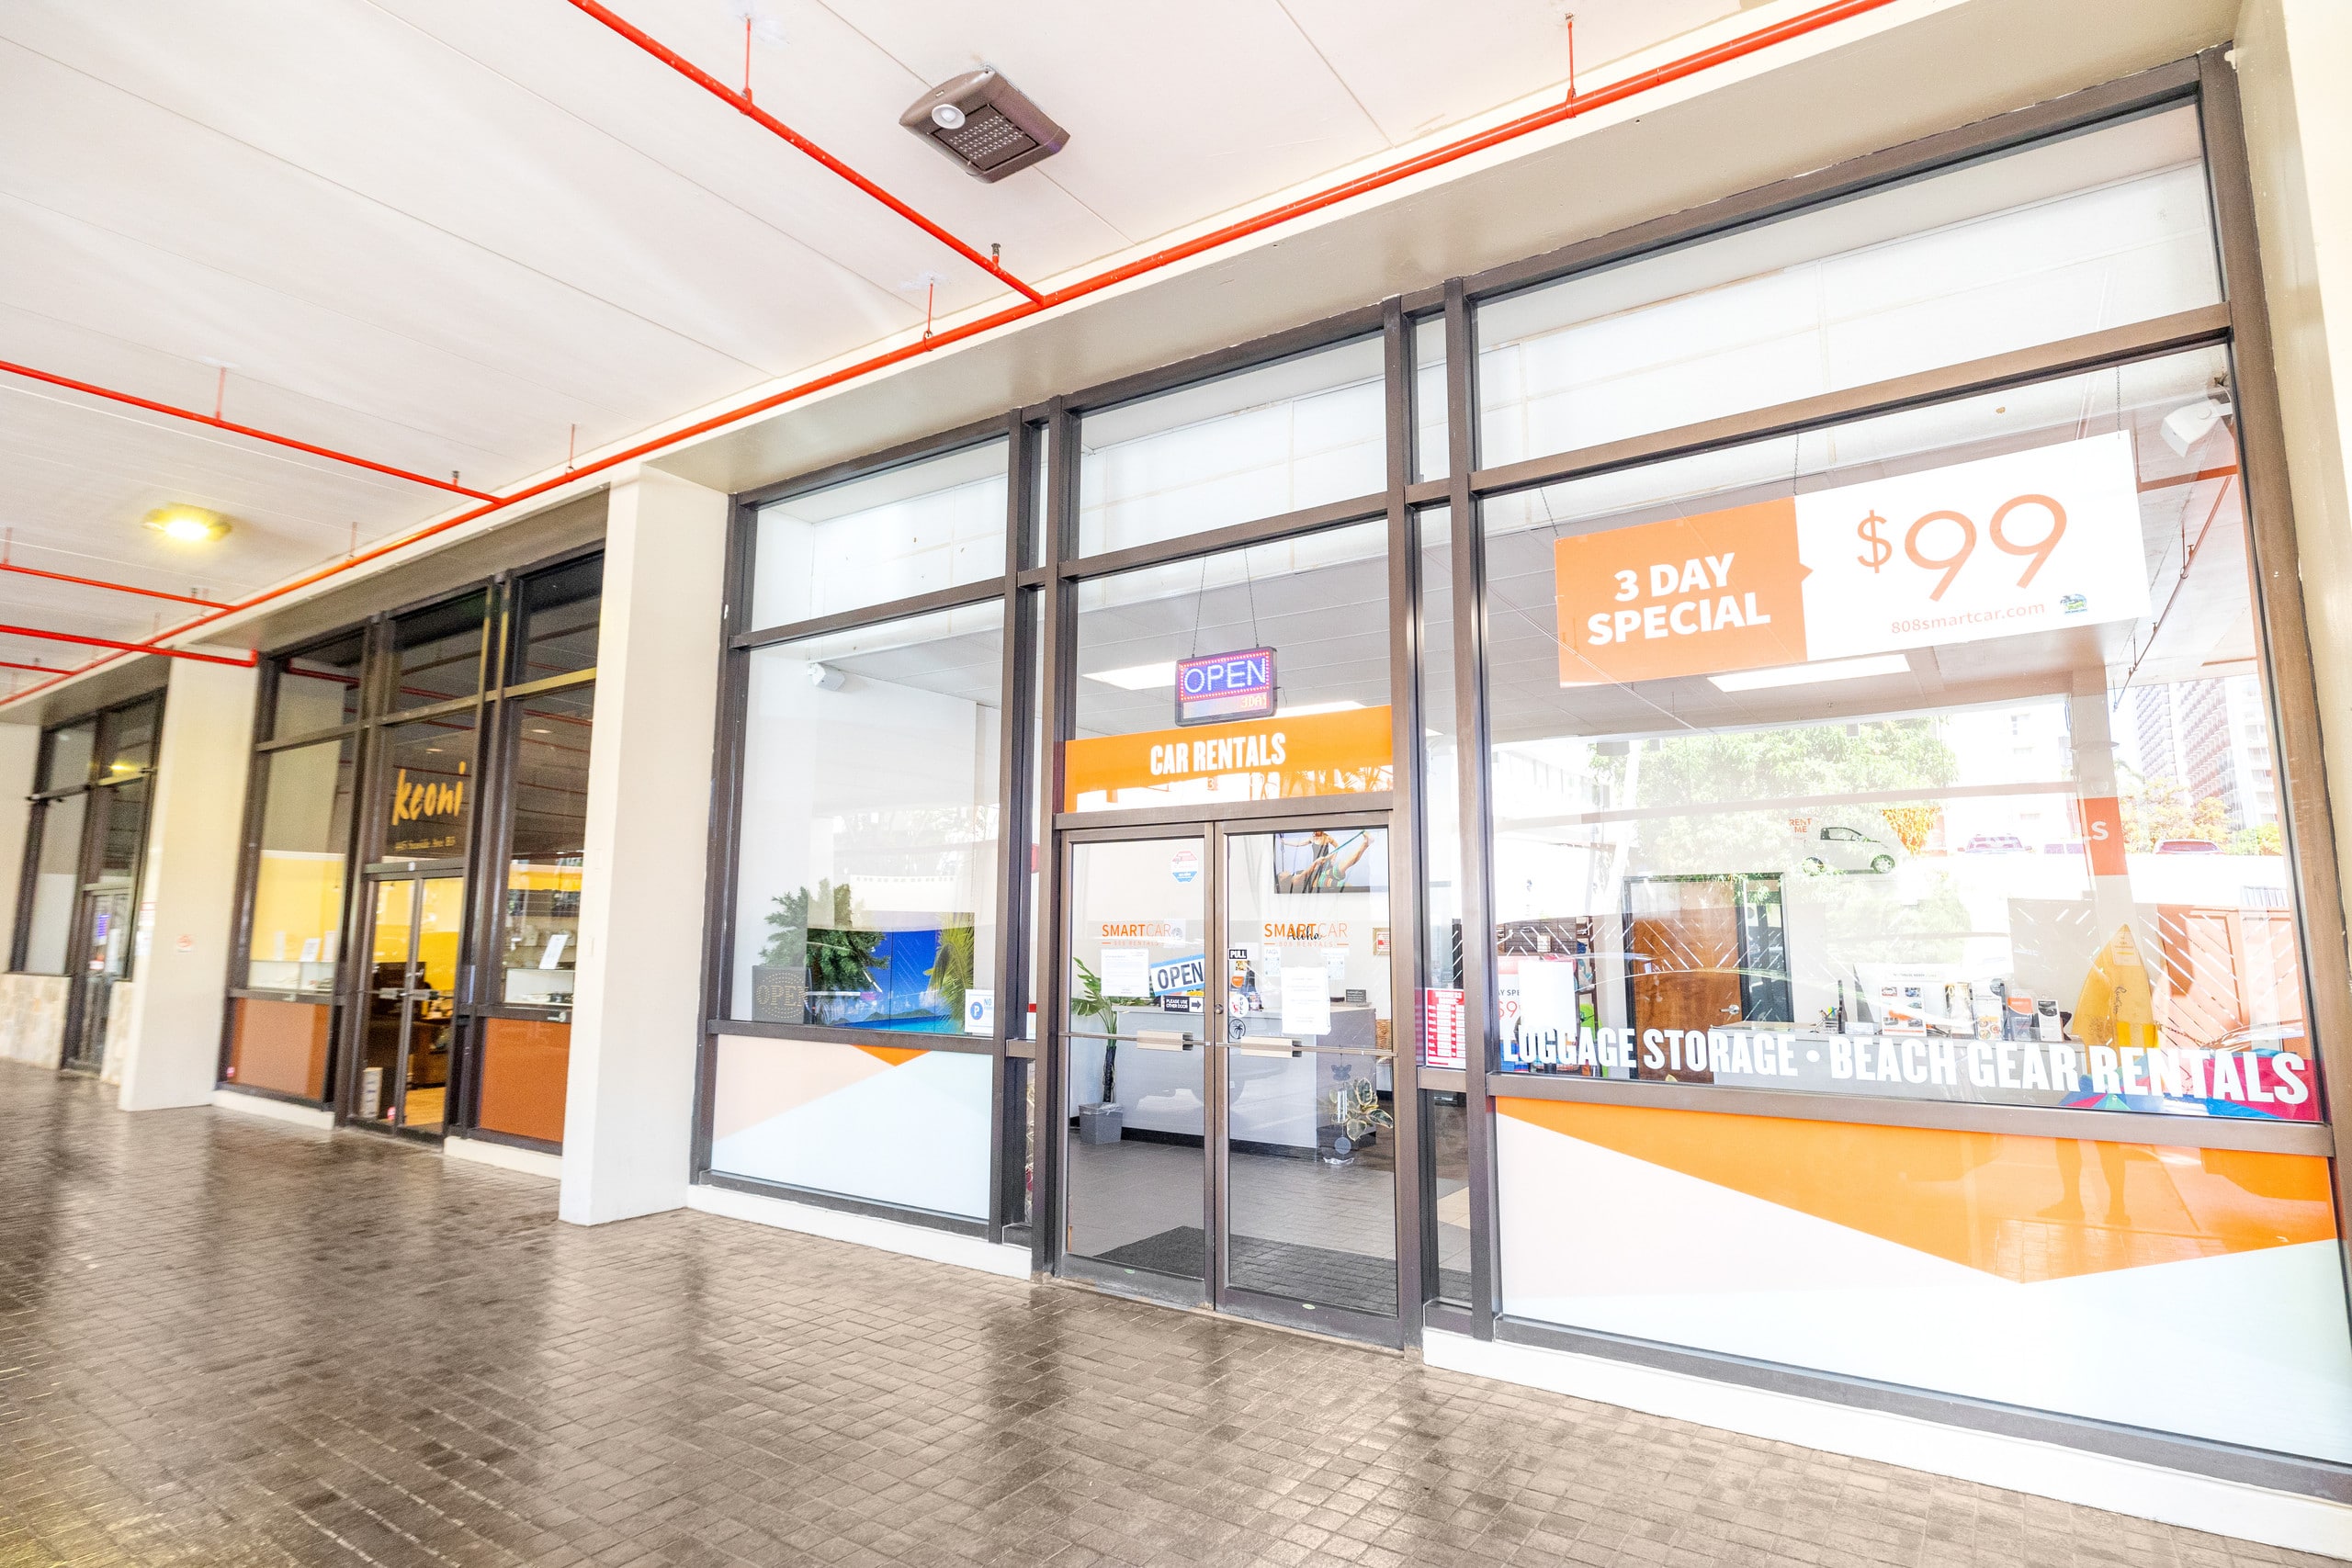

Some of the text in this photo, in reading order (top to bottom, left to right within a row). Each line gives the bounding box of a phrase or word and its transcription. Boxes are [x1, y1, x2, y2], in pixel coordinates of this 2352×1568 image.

[1857, 494, 2067, 602] $99
[1614, 552, 1735, 601] 3 DAY
[1588, 592, 1771, 645] SPECIAL
[1891, 603, 2045, 634] 808smartcar.com
[1184, 658, 1266, 694] OPEN
[1150, 732, 1285, 775] CAR RENTALS
[391, 761, 466, 826] keoni
[1789, 818, 1812, 826] RENT
[1230, 950, 1247, 958] PULL
[1158, 962, 1204, 989] OPEN
[755, 985, 808, 1007] OPEN
[1502, 1027, 1636, 1068] LUGGAGE
[1643, 1028, 1798, 1077] STORAGE
[1829, 1036, 1958, 1085] BEACH
[1967, 1041, 2080, 1092] GEAR
[2088, 1045, 2308, 1105] RENTALS
